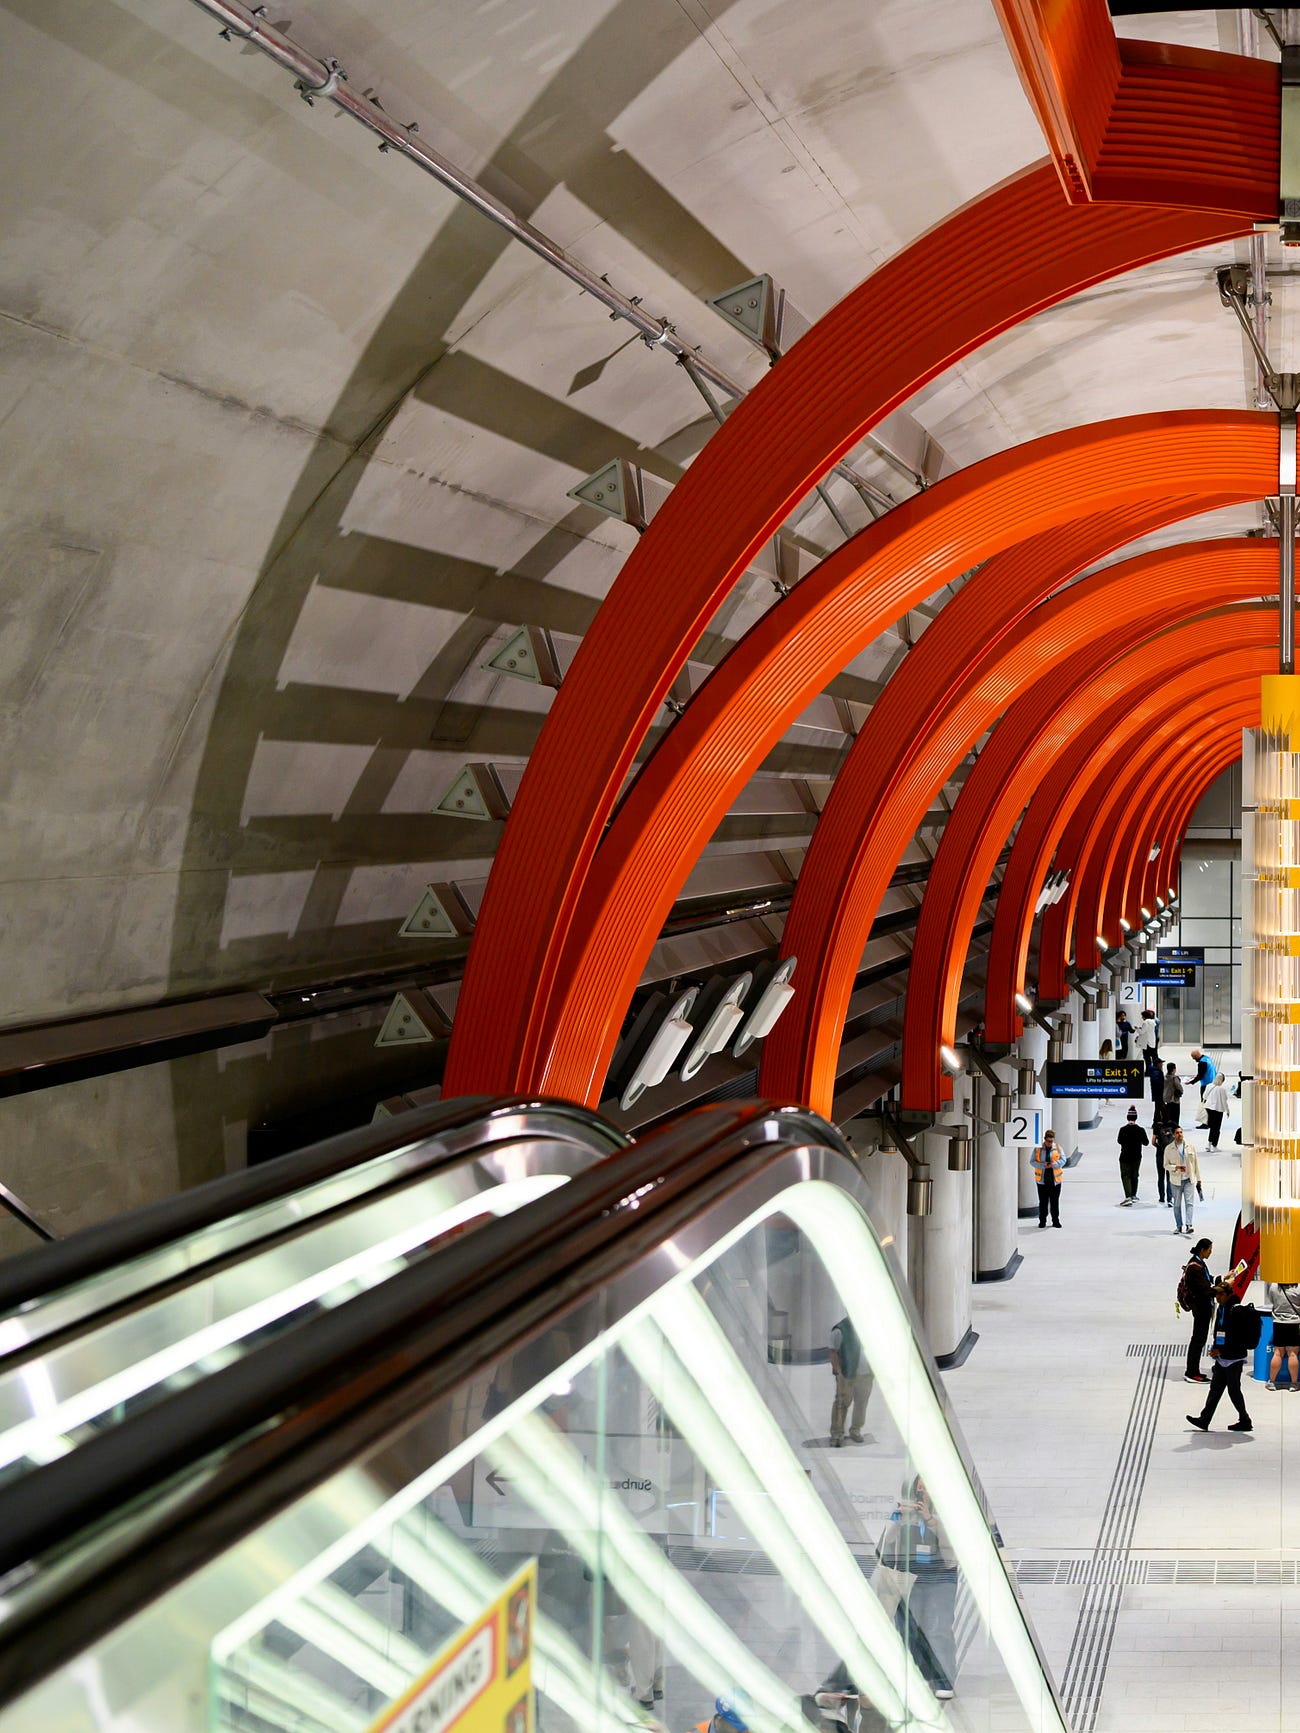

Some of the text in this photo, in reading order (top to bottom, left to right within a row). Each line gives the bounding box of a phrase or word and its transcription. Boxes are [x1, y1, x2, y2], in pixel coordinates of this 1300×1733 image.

[1124, 986, 1134, 1000] 2
[1105, 1068, 1128, 1077] Exit 1
[1012, 1117, 1028, 1140] 2
